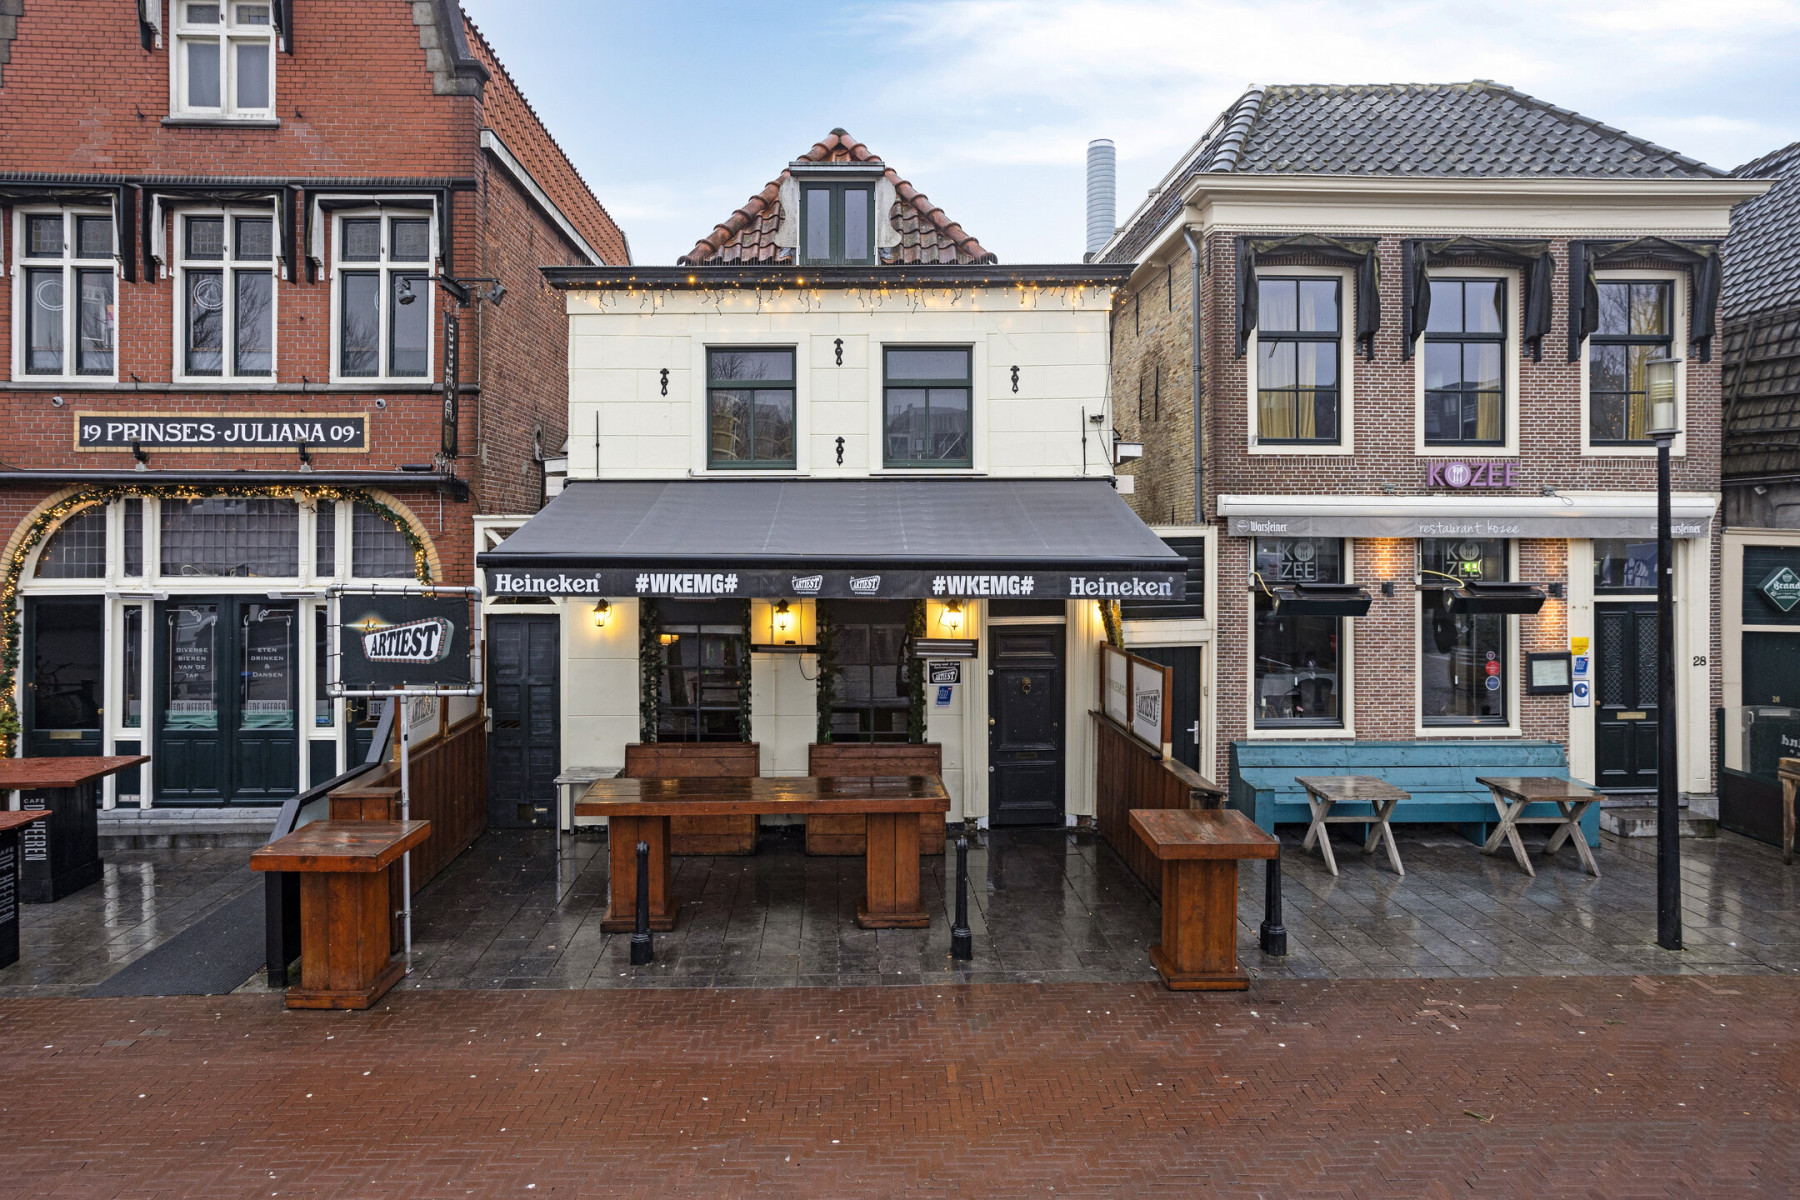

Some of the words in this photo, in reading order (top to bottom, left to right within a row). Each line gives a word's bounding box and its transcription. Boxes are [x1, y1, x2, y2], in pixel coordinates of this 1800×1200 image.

[83, 424, 101, 442] 19
[1428, 461, 1520, 488] KOZEE
[1250, 520, 1288, 533] Warsteiner
[1420, 521, 1482, 534] restaurant
[1487, 520, 1519, 534] kozee
[1670, 521, 1701, 535] arsteiner
[1281, 562, 1314, 578] ZEE
[1446, 561, 1480, 578] ZEE
[635, 573, 739, 594] #WKEMG#
[932, 575, 1035, 596] #WKEMG#
[370, 624, 438, 656] ARTIEST
[1693, 656, 1707, 667] 28
